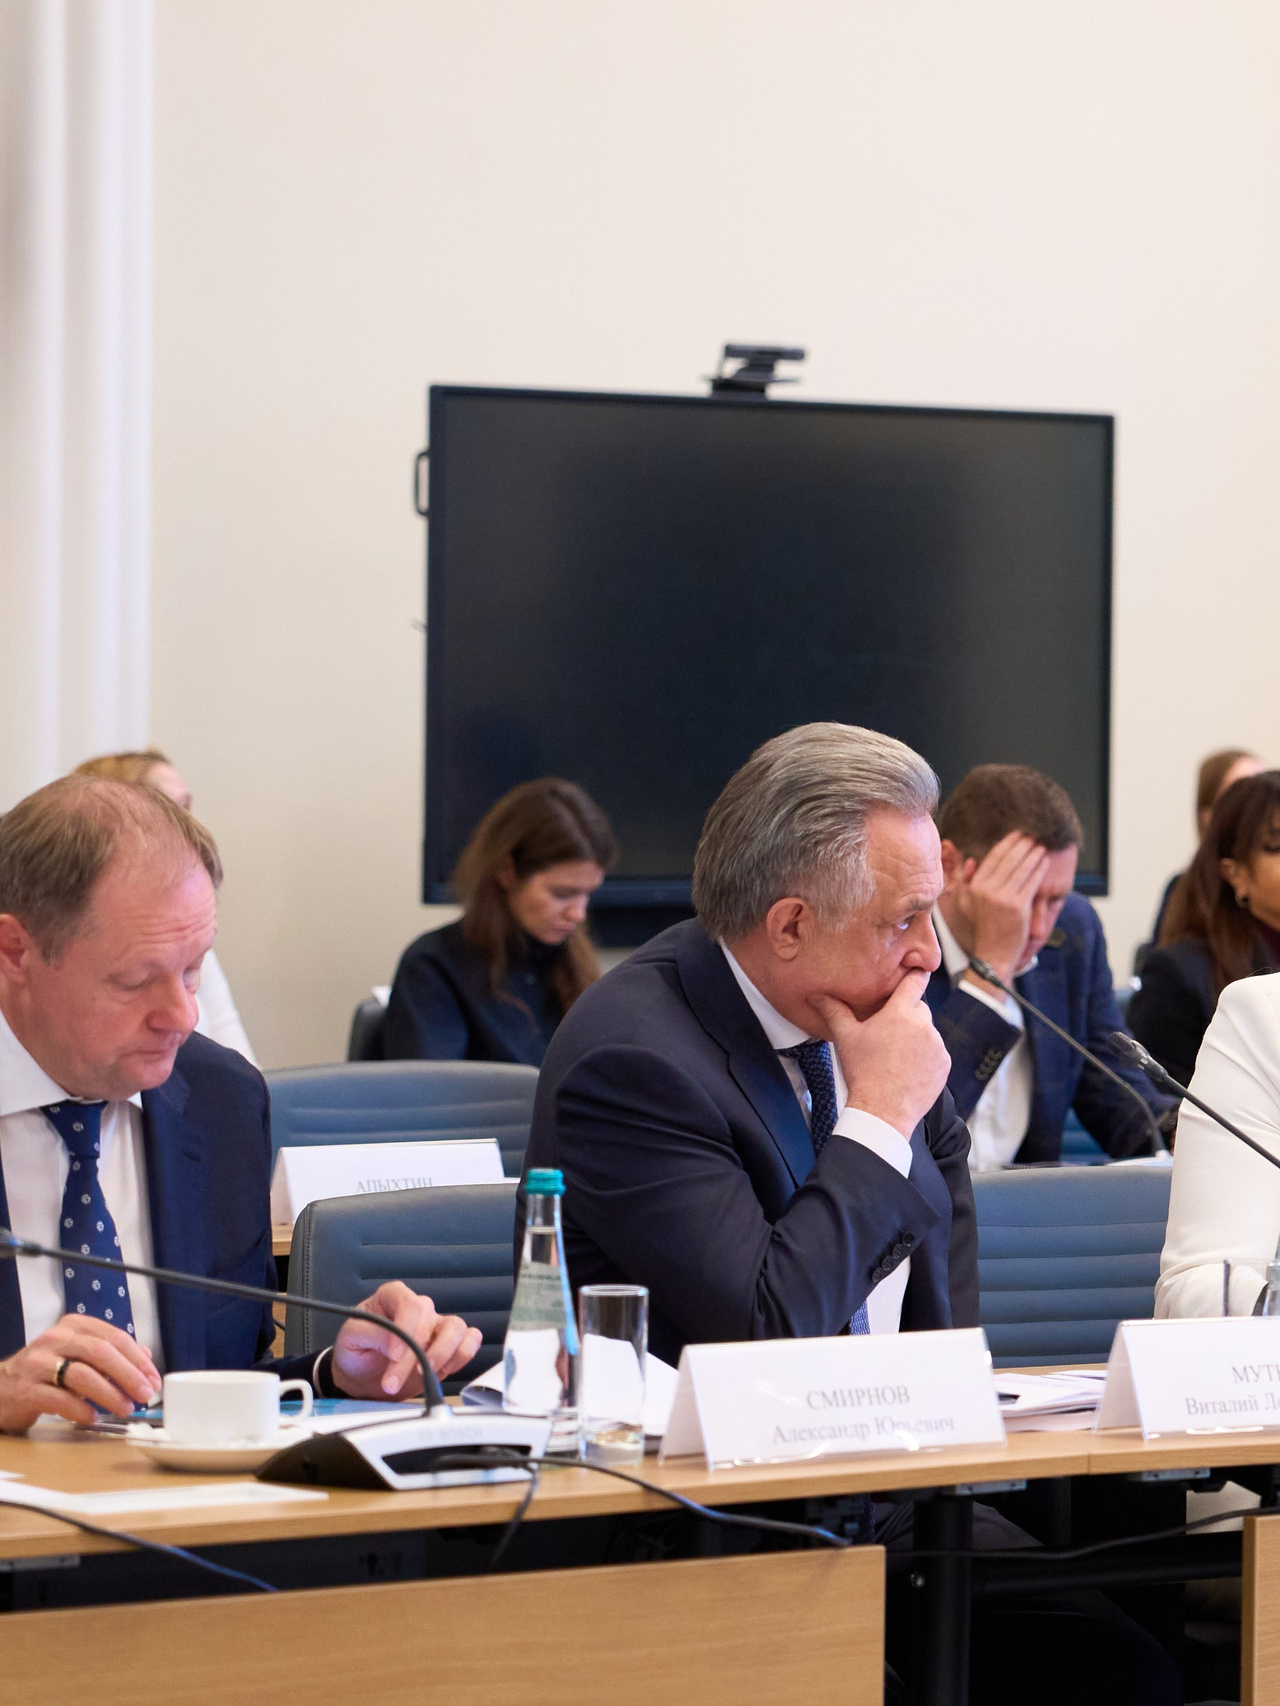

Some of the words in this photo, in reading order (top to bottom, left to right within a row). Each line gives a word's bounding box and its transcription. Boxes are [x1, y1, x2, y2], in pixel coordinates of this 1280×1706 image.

[806, 1385, 911, 1410] СМИРНОВ
[1185, 1394, 1259, 1415] Виталий
[772, 1423, 870, 1443] Александр
